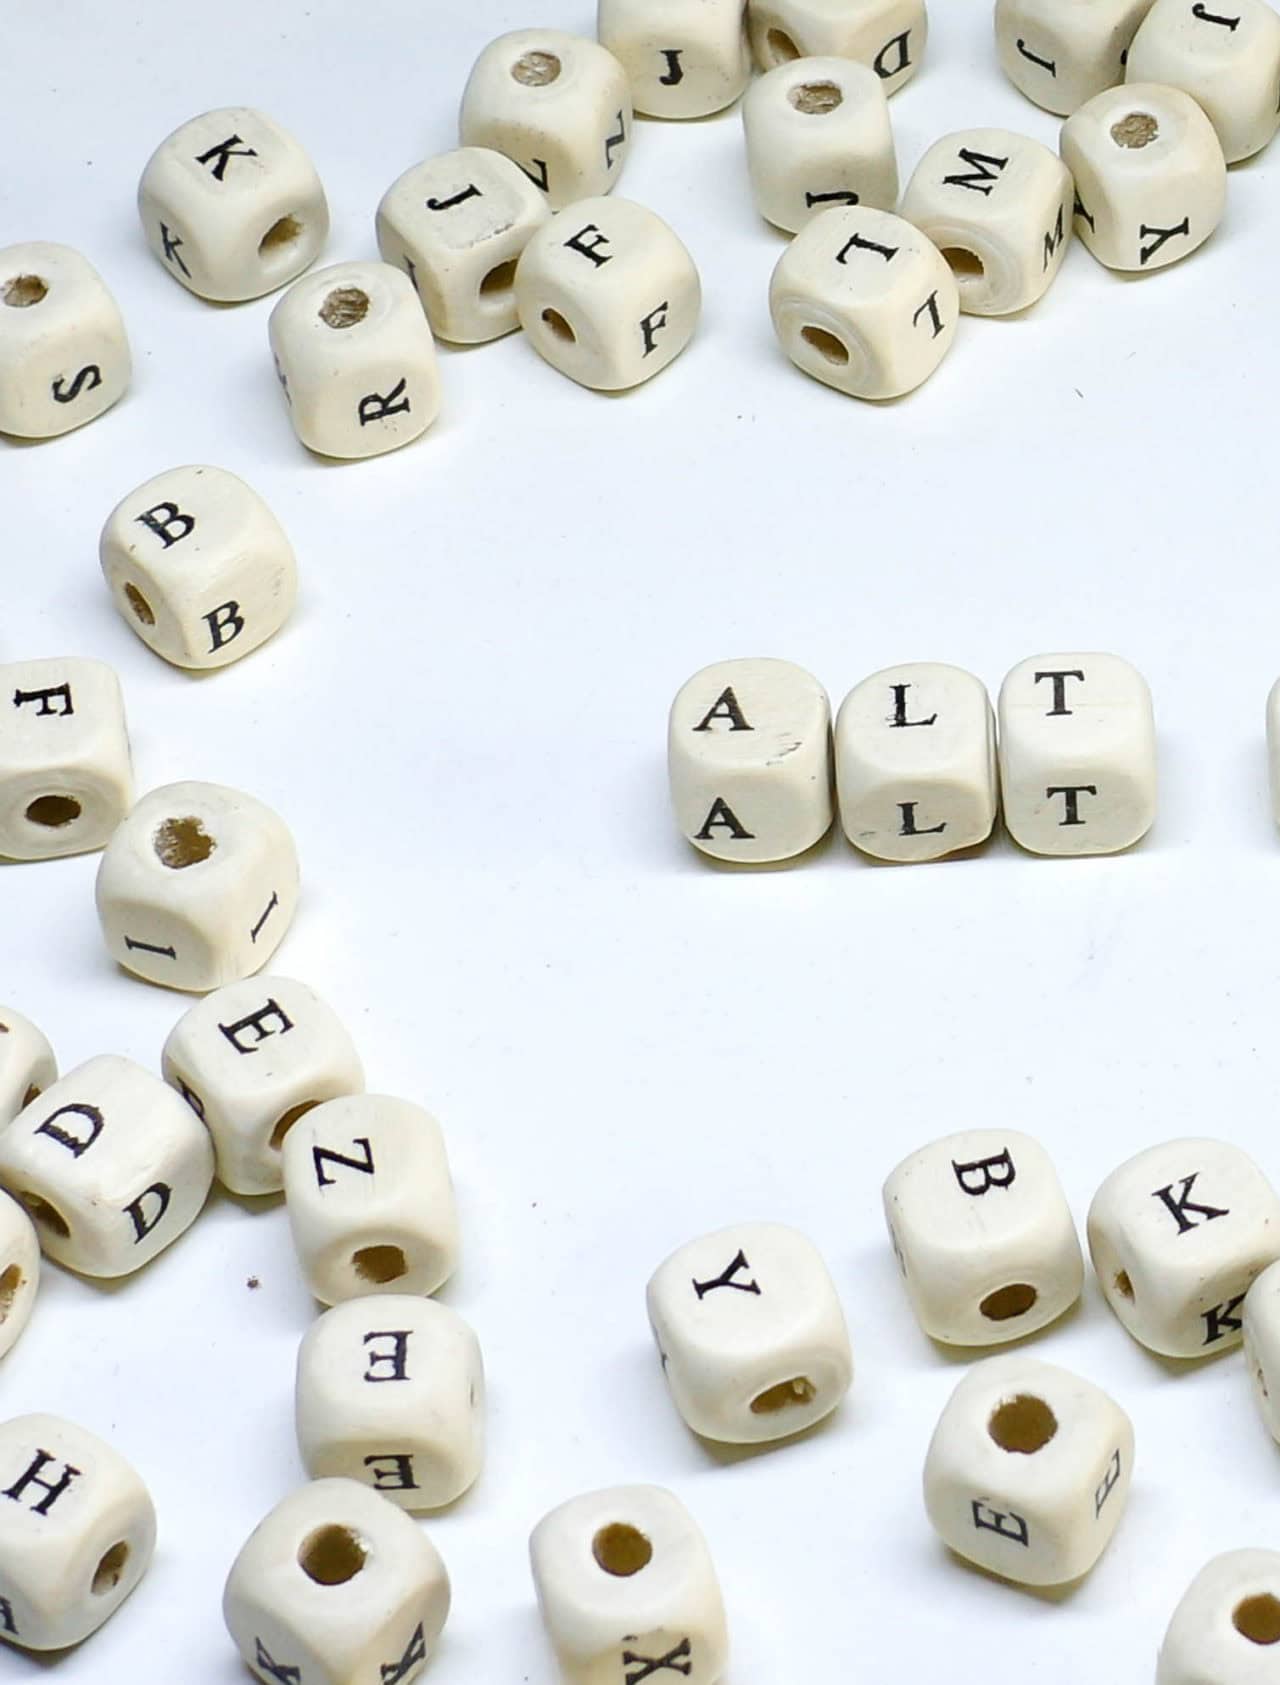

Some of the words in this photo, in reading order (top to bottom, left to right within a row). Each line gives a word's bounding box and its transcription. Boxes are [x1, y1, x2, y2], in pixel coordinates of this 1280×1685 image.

[658, 48, 685, 87] J
[872, 29, 913, 80] D
[194, 133, 258, 182] K
[941, 147, 1010, 197] M
[425, 183, 483, 212] J
[158, 220, 192, 279] K
[563, 223, 613, 269] F
[834, 232, 900, 266] L
[1138, 216, 1190, 266] Y
[639, 300, 669, 357] F
[912, 288, 945, 338] L
[51, 363, 103, 405] S
[357, 377, 412, 428] R
[135, 501, 196, 550] B
[201, 600, 245, 654] B
[12, 682, 75, 718] F
[692, 669, 1086, 733] ALT
[693, 784, 1098, 841] ALT
[217, 997, 294, 1055] E
[33, 1102, 105, 1159] D
[950, 1147, 1017, 1197] B
[121, 1181, 173, 1246] D
[1152, 1172, 1230, 1235] K
[691, 1249, 762, 1301] Y
[1200, 1291, 1245, 1346] K
[363, 1330, 413, 1383] E
[1, 1448, 82, 1517] H
[362, 1453, 421, 1492] E
[970, 1498, 1030, 1549] E
[621, 1635, 693, 1685] X
